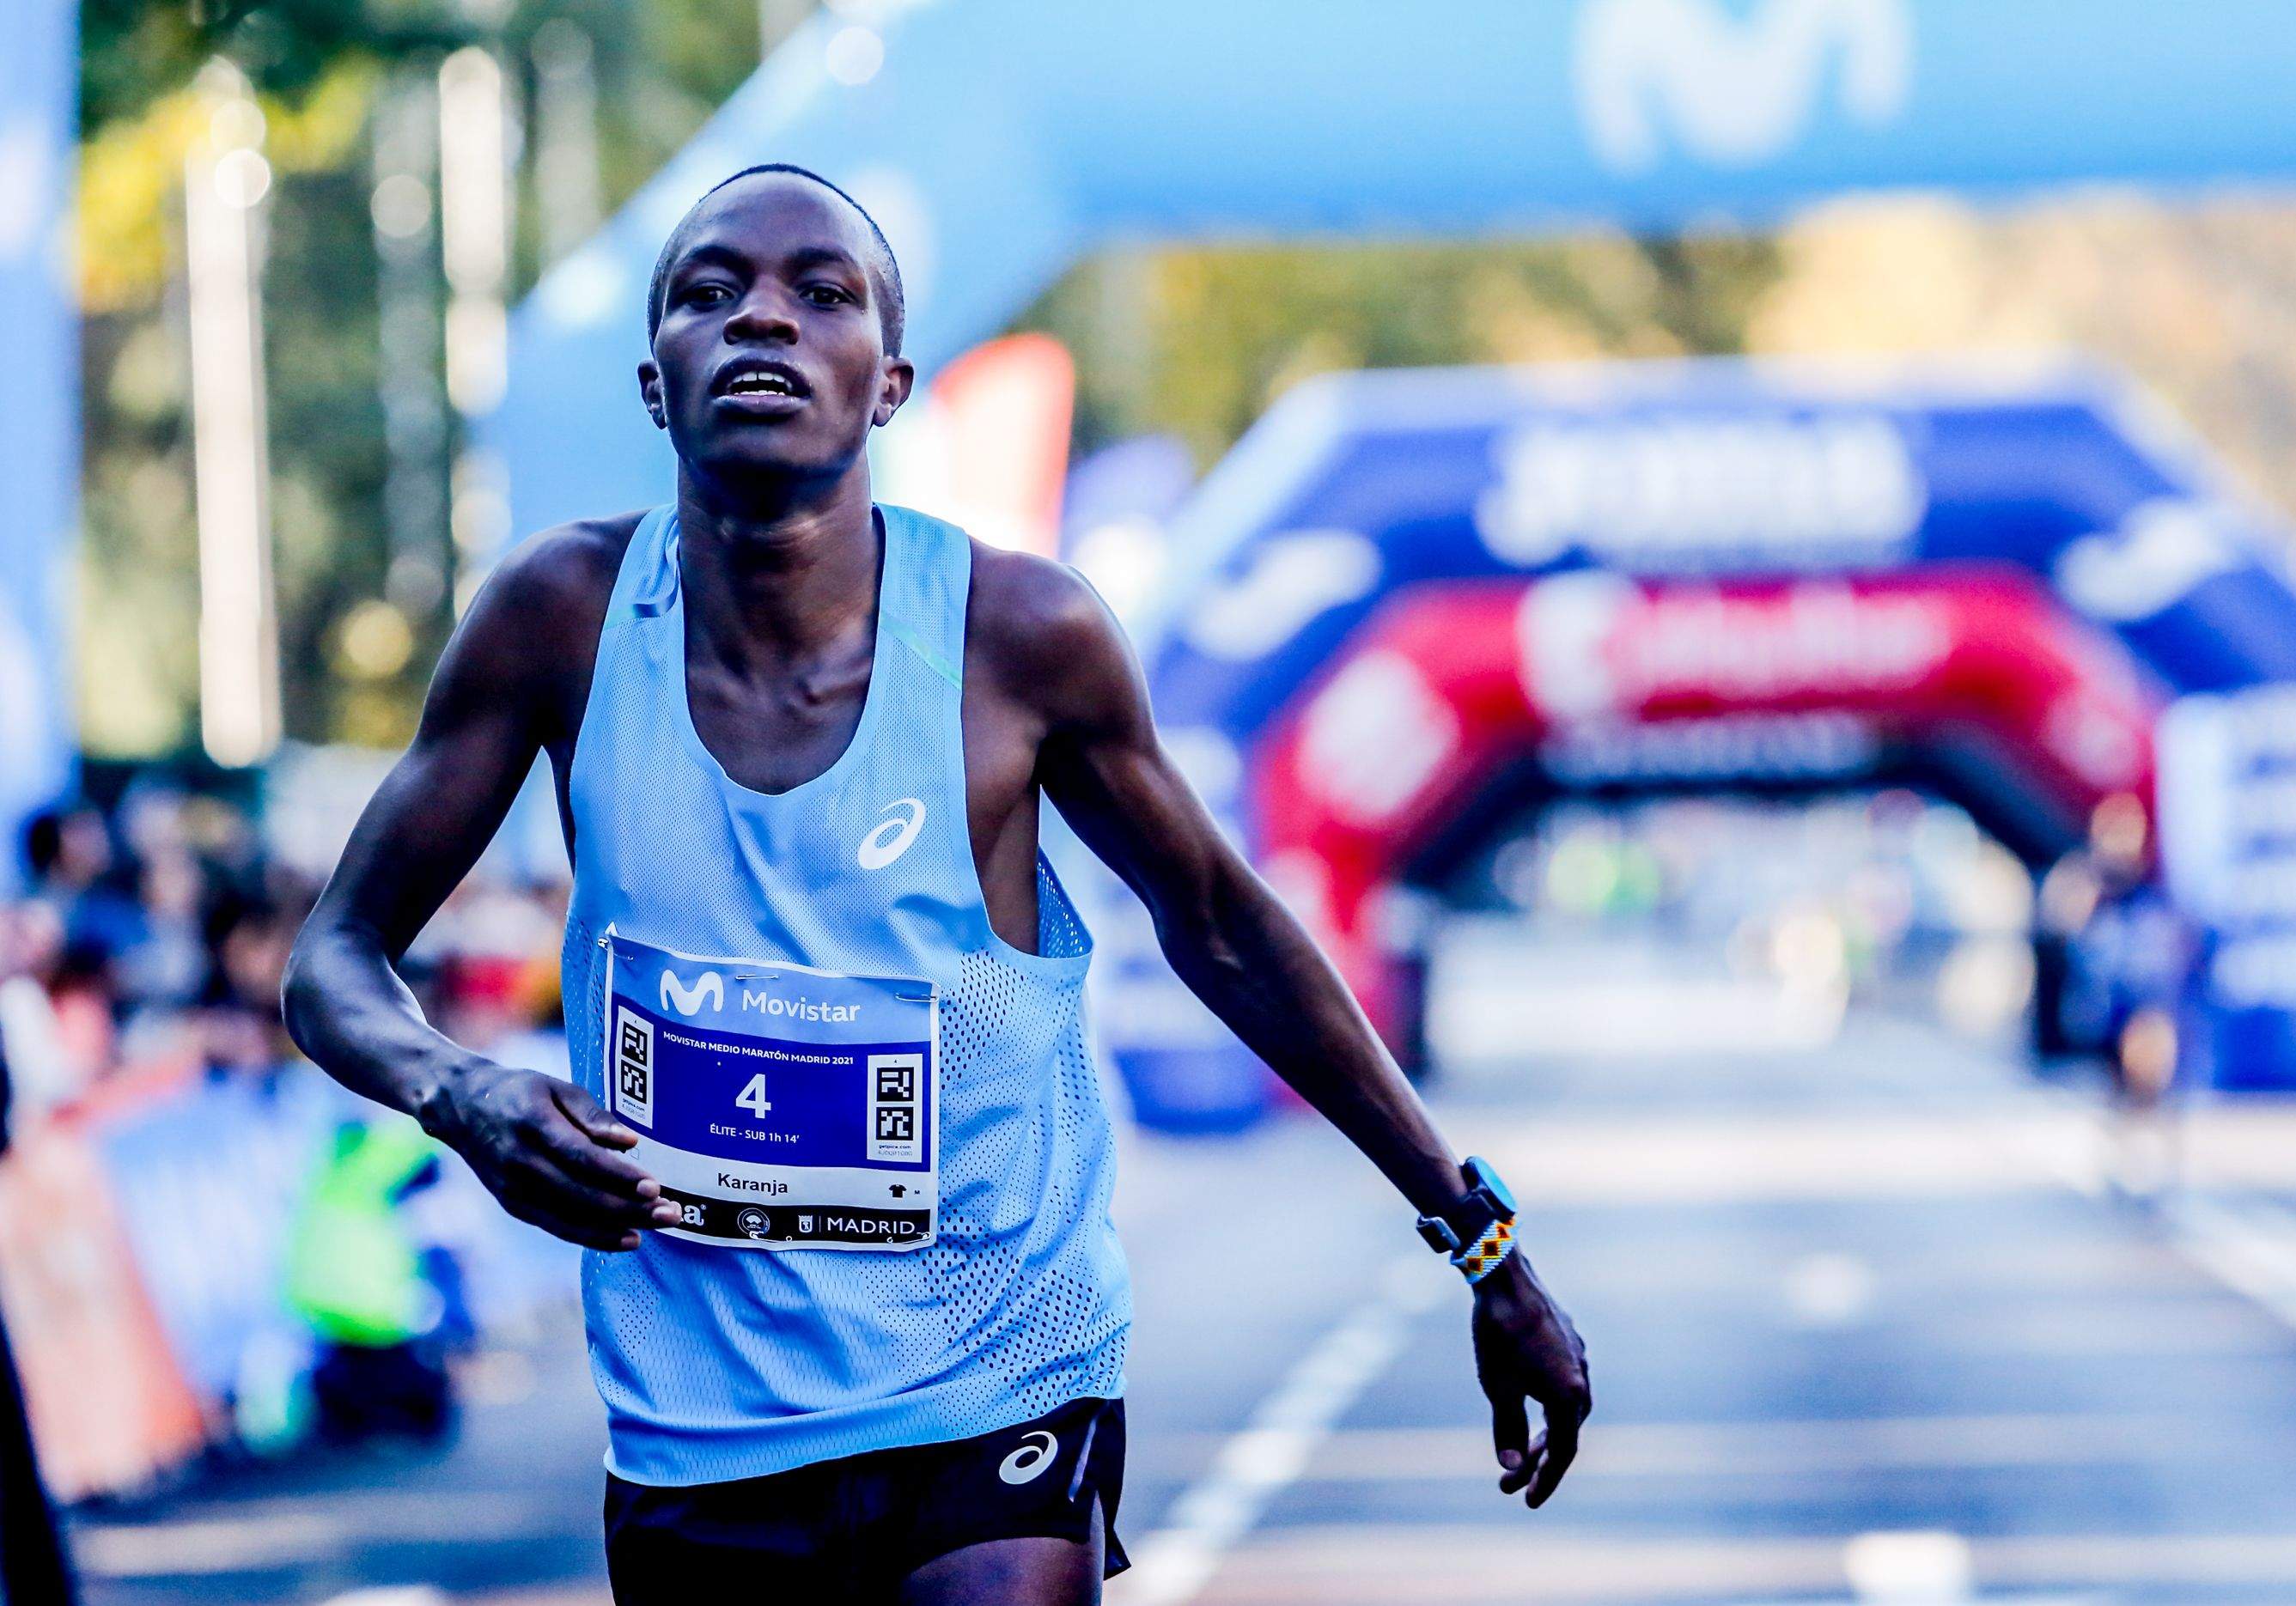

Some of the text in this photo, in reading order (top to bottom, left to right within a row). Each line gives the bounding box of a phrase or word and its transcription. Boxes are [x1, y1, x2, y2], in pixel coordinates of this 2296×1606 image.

[741, 989, 861, 1022] Movistar
[663, 1031, 854, 1065] MOVISTAR MEDIO MARATÓN MADRID 2021
[735, 1074, 771, 1118] 4
[710, 1122, 736, 1137] ÉLITE
[745, 1129, 765, 1141] SUB
[769, 1133, 782, 1142] 1h
[717, 1172, 789, 1196] Karanja
[827, 1217, 916, 1235] MADRID
